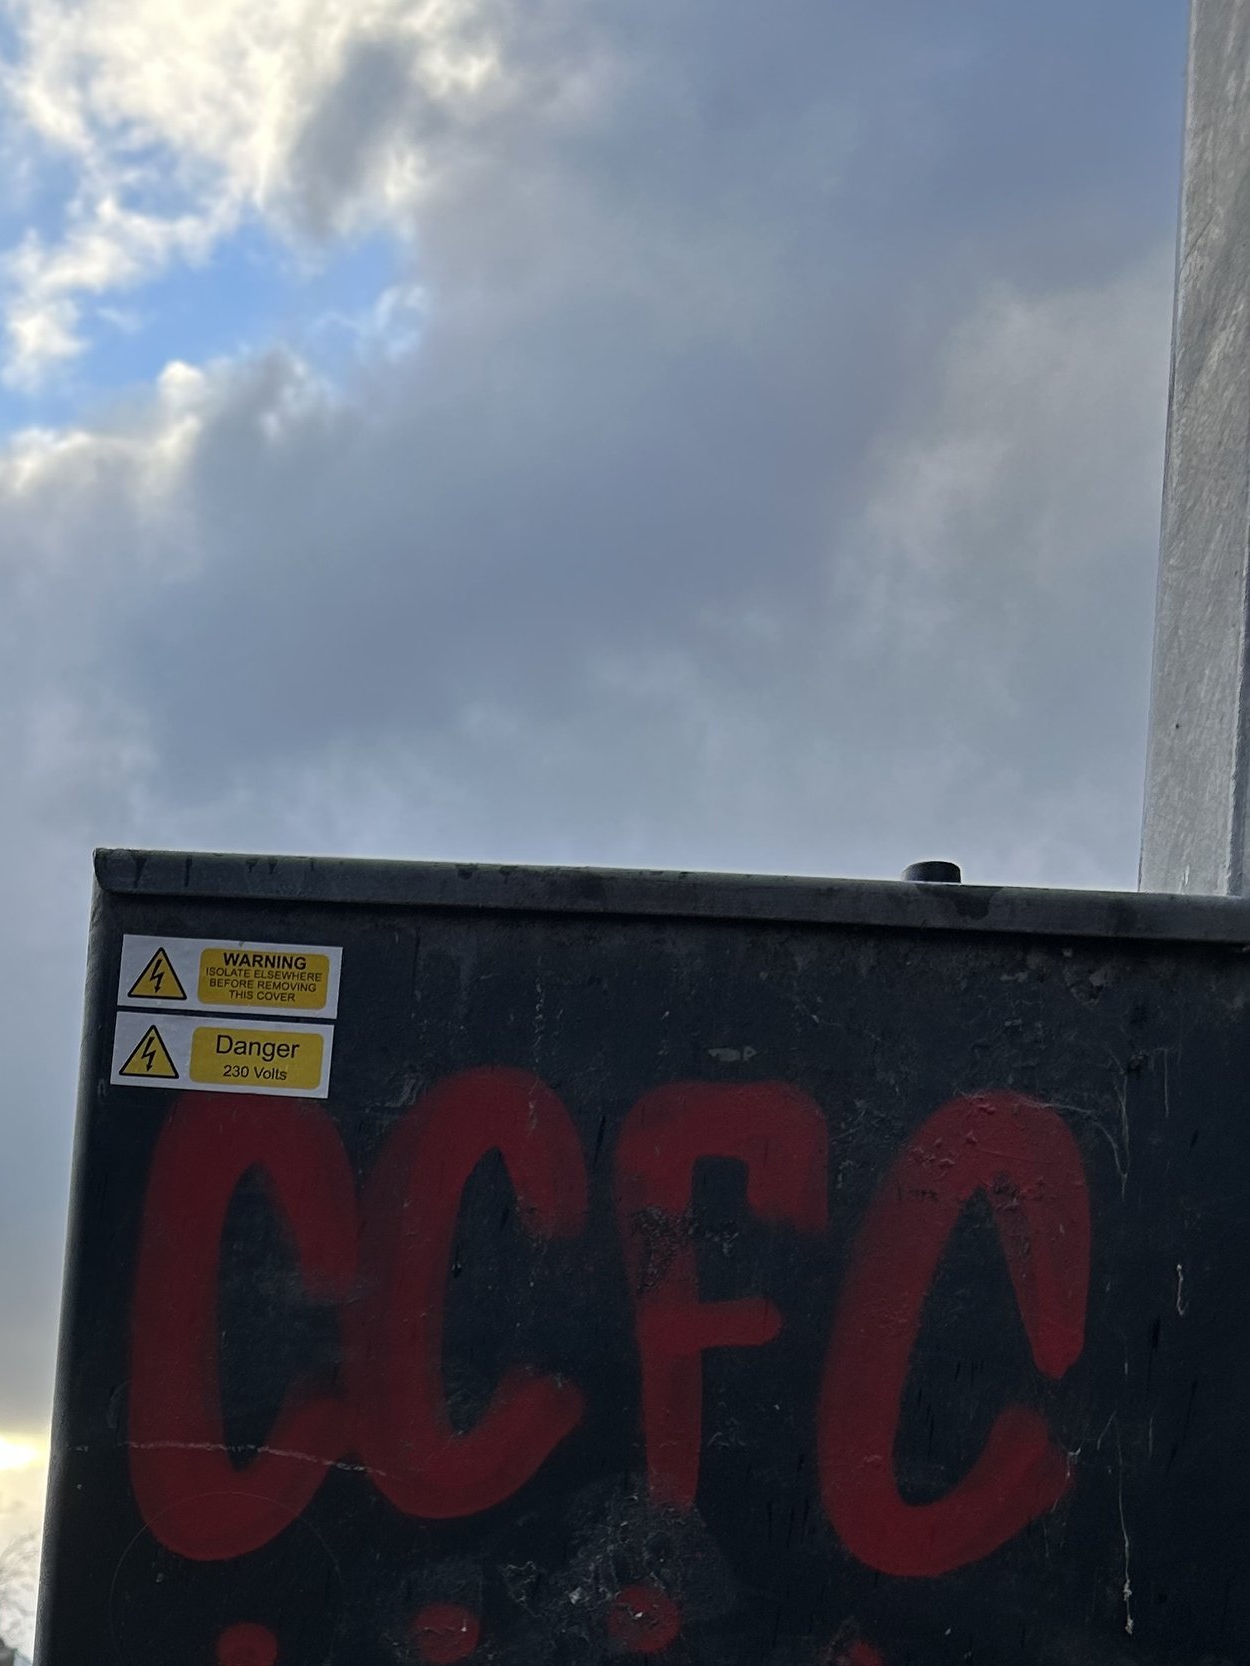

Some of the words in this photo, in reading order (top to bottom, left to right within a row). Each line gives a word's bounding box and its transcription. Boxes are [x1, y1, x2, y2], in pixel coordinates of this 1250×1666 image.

[223, 952, 307, 970] WARNING
[205, 967, 250, 978] ISOLATE
[253, 969, 322, 982] ELSEWHERE
[209, 978, 254, 989] BEFORE
[257, 981, 317, 993] REMOVING
[229, 990, 253, 1000] THIS
[256, 991, 295, 1002] COVER
[216, 1034, 300, 1062] Danger
[223, 1065, 249, 1078] 230
[254, 1067, 287, 1081] Volts
[126, 1065, 1091, 1577] CCFC
